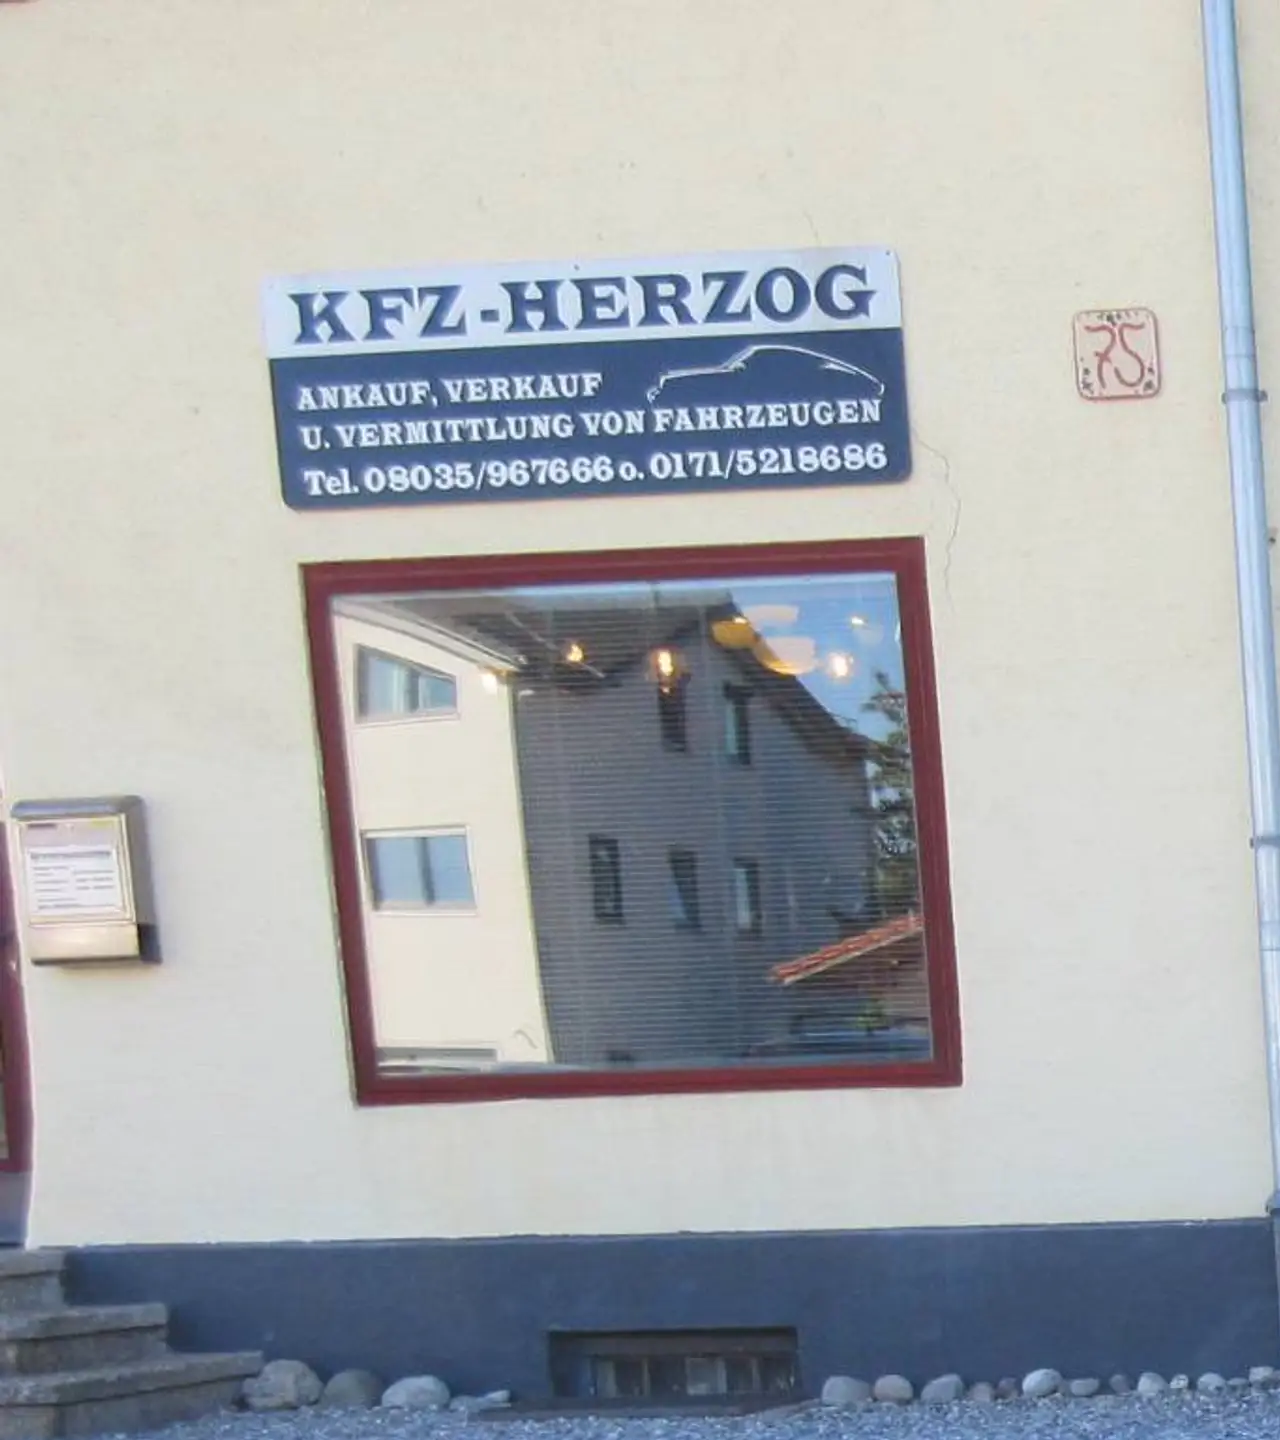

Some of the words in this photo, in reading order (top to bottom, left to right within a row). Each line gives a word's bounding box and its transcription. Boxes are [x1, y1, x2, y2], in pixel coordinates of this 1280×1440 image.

[289, 263, 877, 345] KFZ-HERZOG
[297, 379, 439, 411] ANKAUF,
[441, 371, 603, 404] VERKAUF
[300, 425, 332, 450] U.
[335, 414, 576, 449] VERMITTLUNG
[579, 409, 645, 437] VON
[653, 399, 883, 433] FAHRZEUGEN
[303, 467, 360, 496] Tel.
[363, 455, 614, 493] 08035/967666
[650, 442, 888, 480] 0171/5218686
